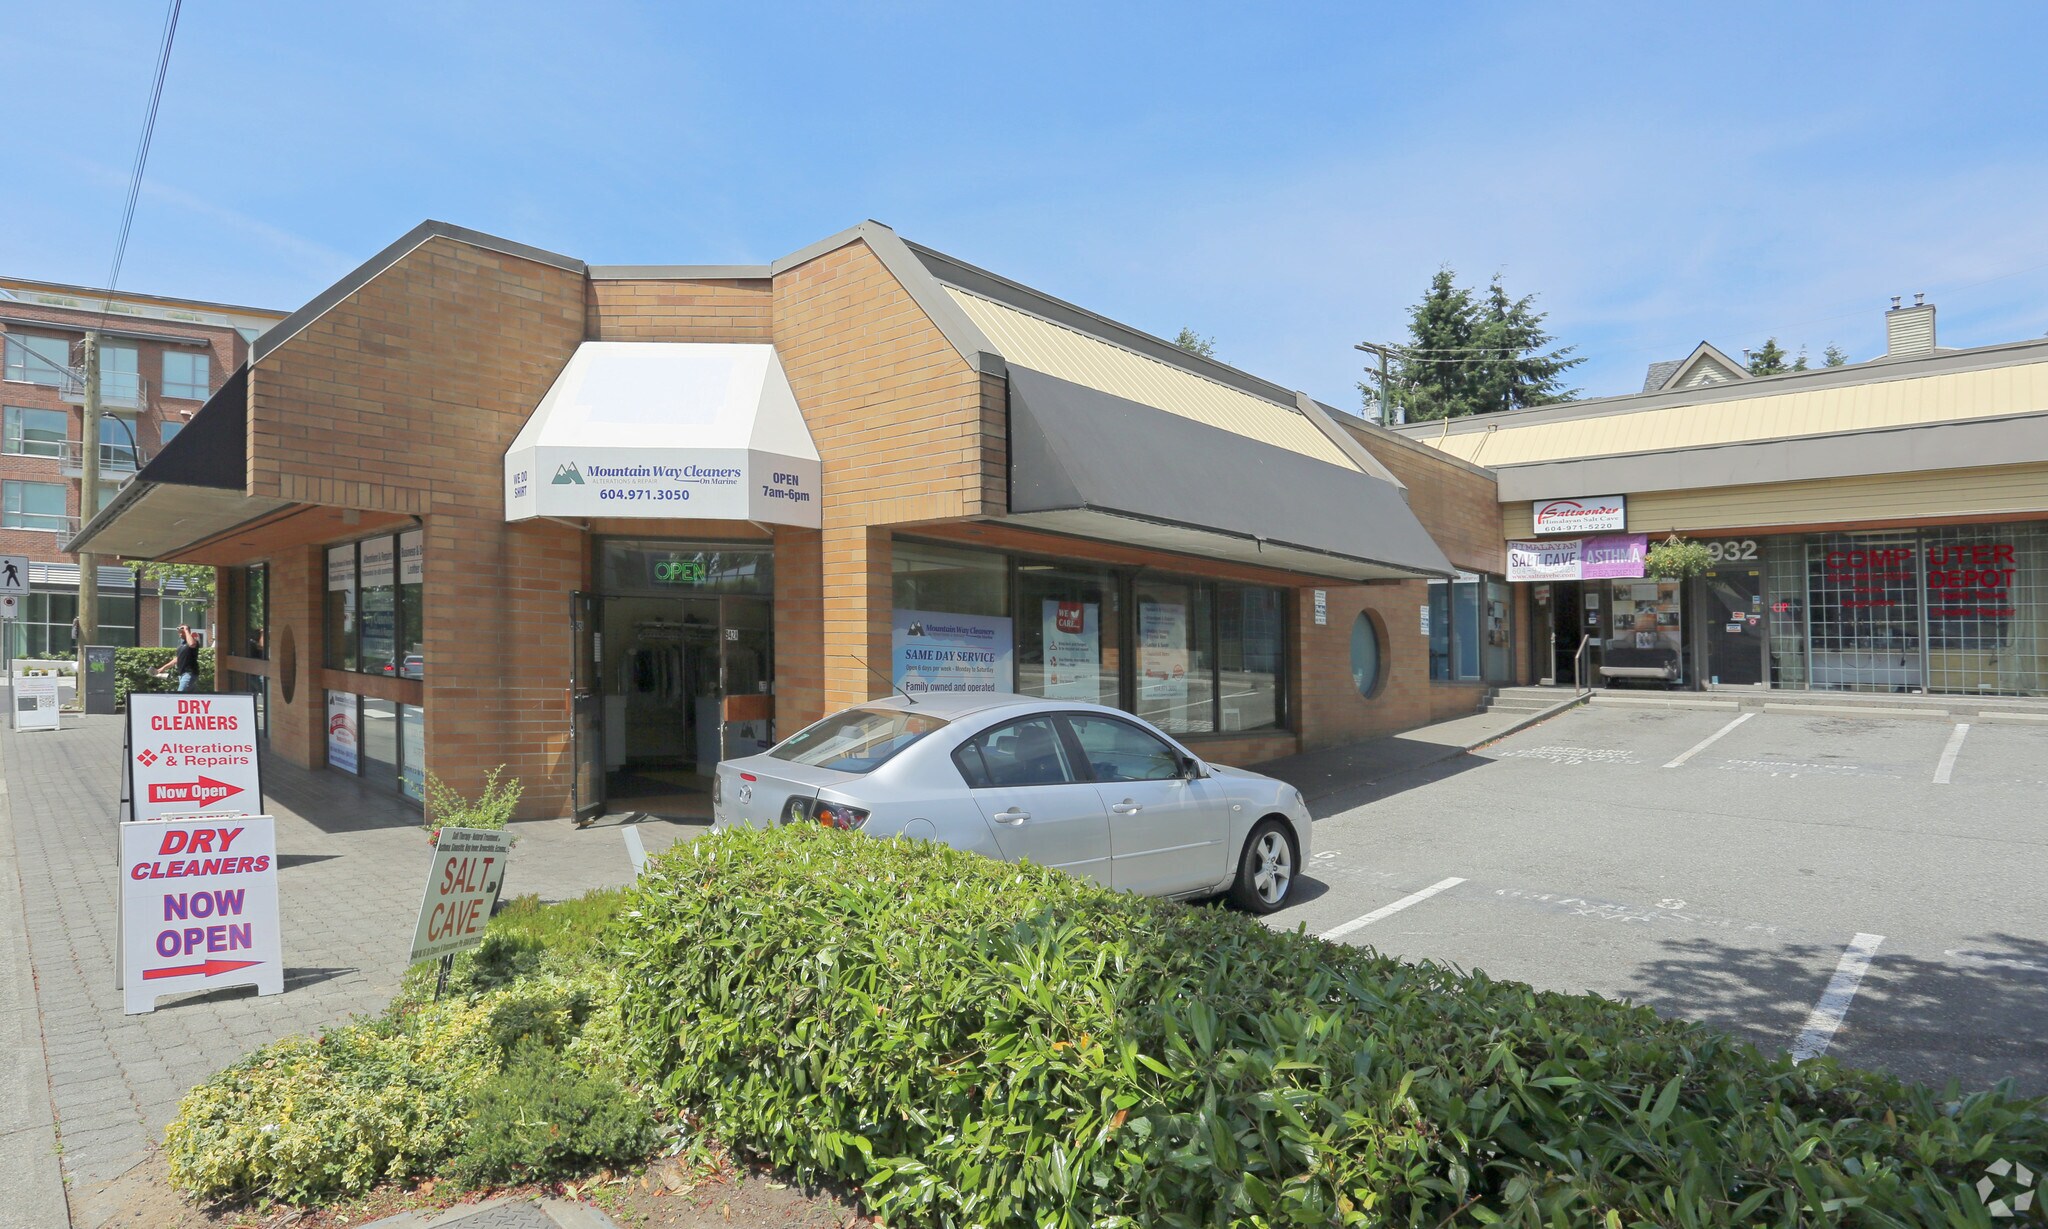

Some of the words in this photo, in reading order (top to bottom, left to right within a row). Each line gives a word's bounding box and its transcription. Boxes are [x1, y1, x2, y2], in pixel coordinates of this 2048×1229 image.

[587, 465, 650, 478] Mountain
[653, 466, 682, 481] Way
[683, 466, 741, 478] Cleaners
[773, 472, 799, 486] OPEN
[600, 489, 690, 500] 604.971.3050
[762, 486, 810, 502] 7am-6pm
[1545, 523, 1612, 532] 604-971-5220
[1512, 542, 1577, 550] HIMALAYAN
[1707, 540, 1758, 562] 932
[1512, 553, 1541, 567] SALT
[1544, 552, 1576, 567] CAVE
[1586, 548, 1640, 564] ASTHMA
[654, 562, 705, 581] OPEN
[1585, 569, 1640, 577] TREATMENT
[1929, 569, 2016, 589] DEPOT
[1059, 609, 1068, 617] WE
[926, 624, 955, 633] Mountain
[956, 626, 969, 634] Way
[970, 626, 994, 635] Cleaners
[905, 650, 934, 660] SAME
[935, 651, 956, 661] DAY
[956, 652, 995, 662] SERVICE
[906, 682, 928, 692] Family
[930, 683, 952, 691] owned
[954, 683, 966, 691] and
[968, 683, 995, 692] operated
[178, 700, 211, 714] DRY
[151, 715, 238, 731] CLEANERS
[159, 742, 253, 754] Alterations
[166, 756, 177, 767] &
[184, 755, 249, 768] Repairs
[156, 785, 189, 800] Now
[192, 784, 227, 800] Open
[159, 828, 244, 855] DRY
[131, 856, 270, 880] CLEANERS
[440, 857, 494, 895] SALT
[163, 888, 245, 922] NOW
[428, 899, 484, 942] CAVE
[156, 922, 252, 958] OPEN
